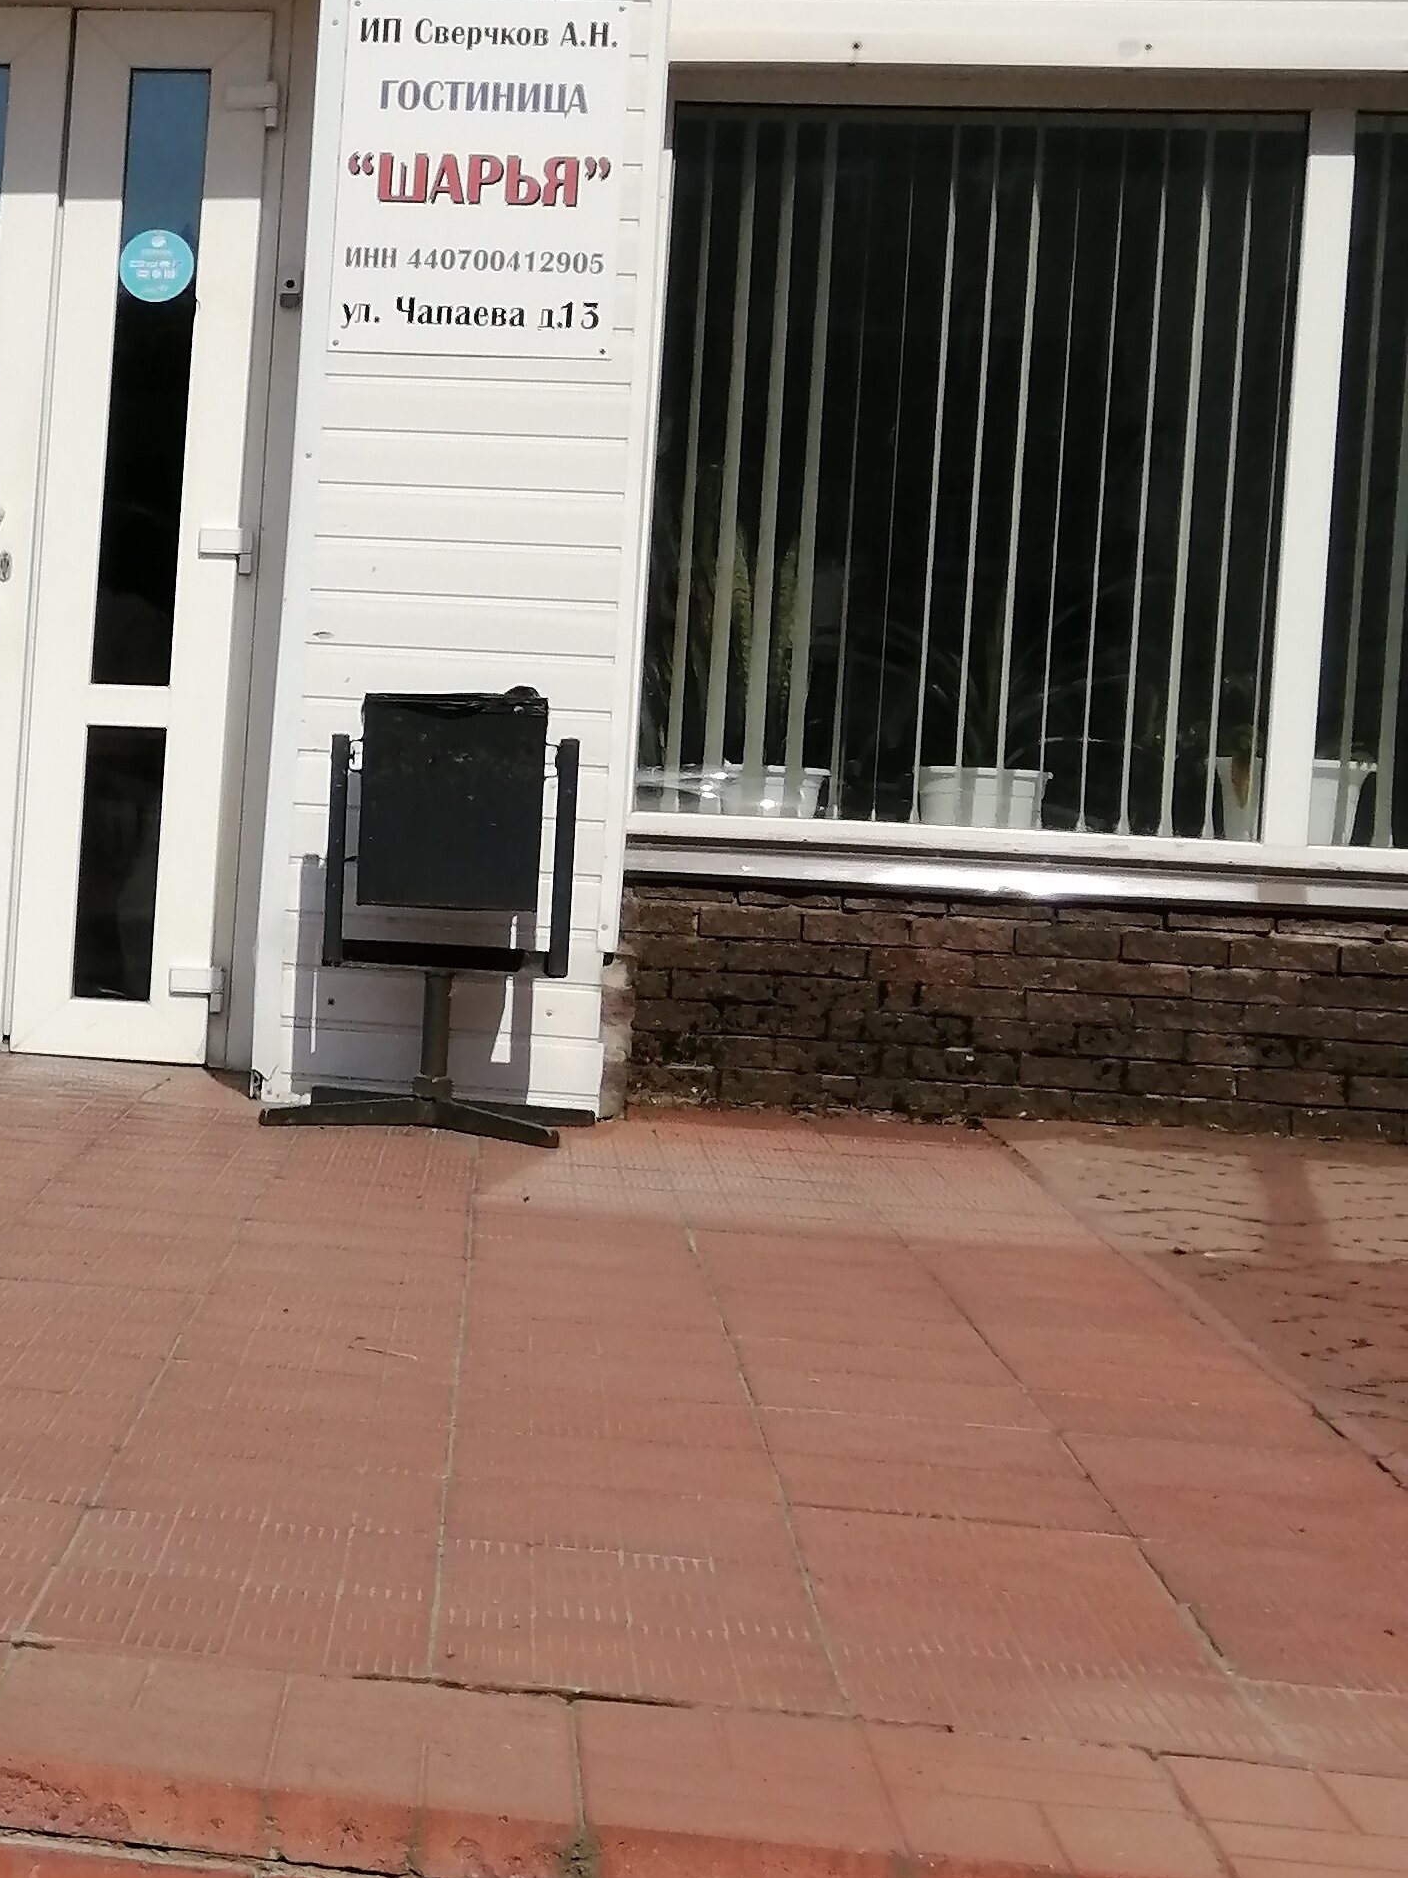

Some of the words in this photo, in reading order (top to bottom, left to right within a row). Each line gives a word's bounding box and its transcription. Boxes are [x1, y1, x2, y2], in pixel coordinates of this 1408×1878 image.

[360, 17, 402, 43] ИП
[414, 18, 550, 50] Сверчков
[559, 21, 619, 48] А.Н.
[380, 79, 589, 118] ГОСТИНИЦА
[344, 246, 398, 269] ИНН
[406, 248, 605, 274] 440700412905
[340, 302, 381, 329] ул.
[395, 296, 527, 327] Чапаева
